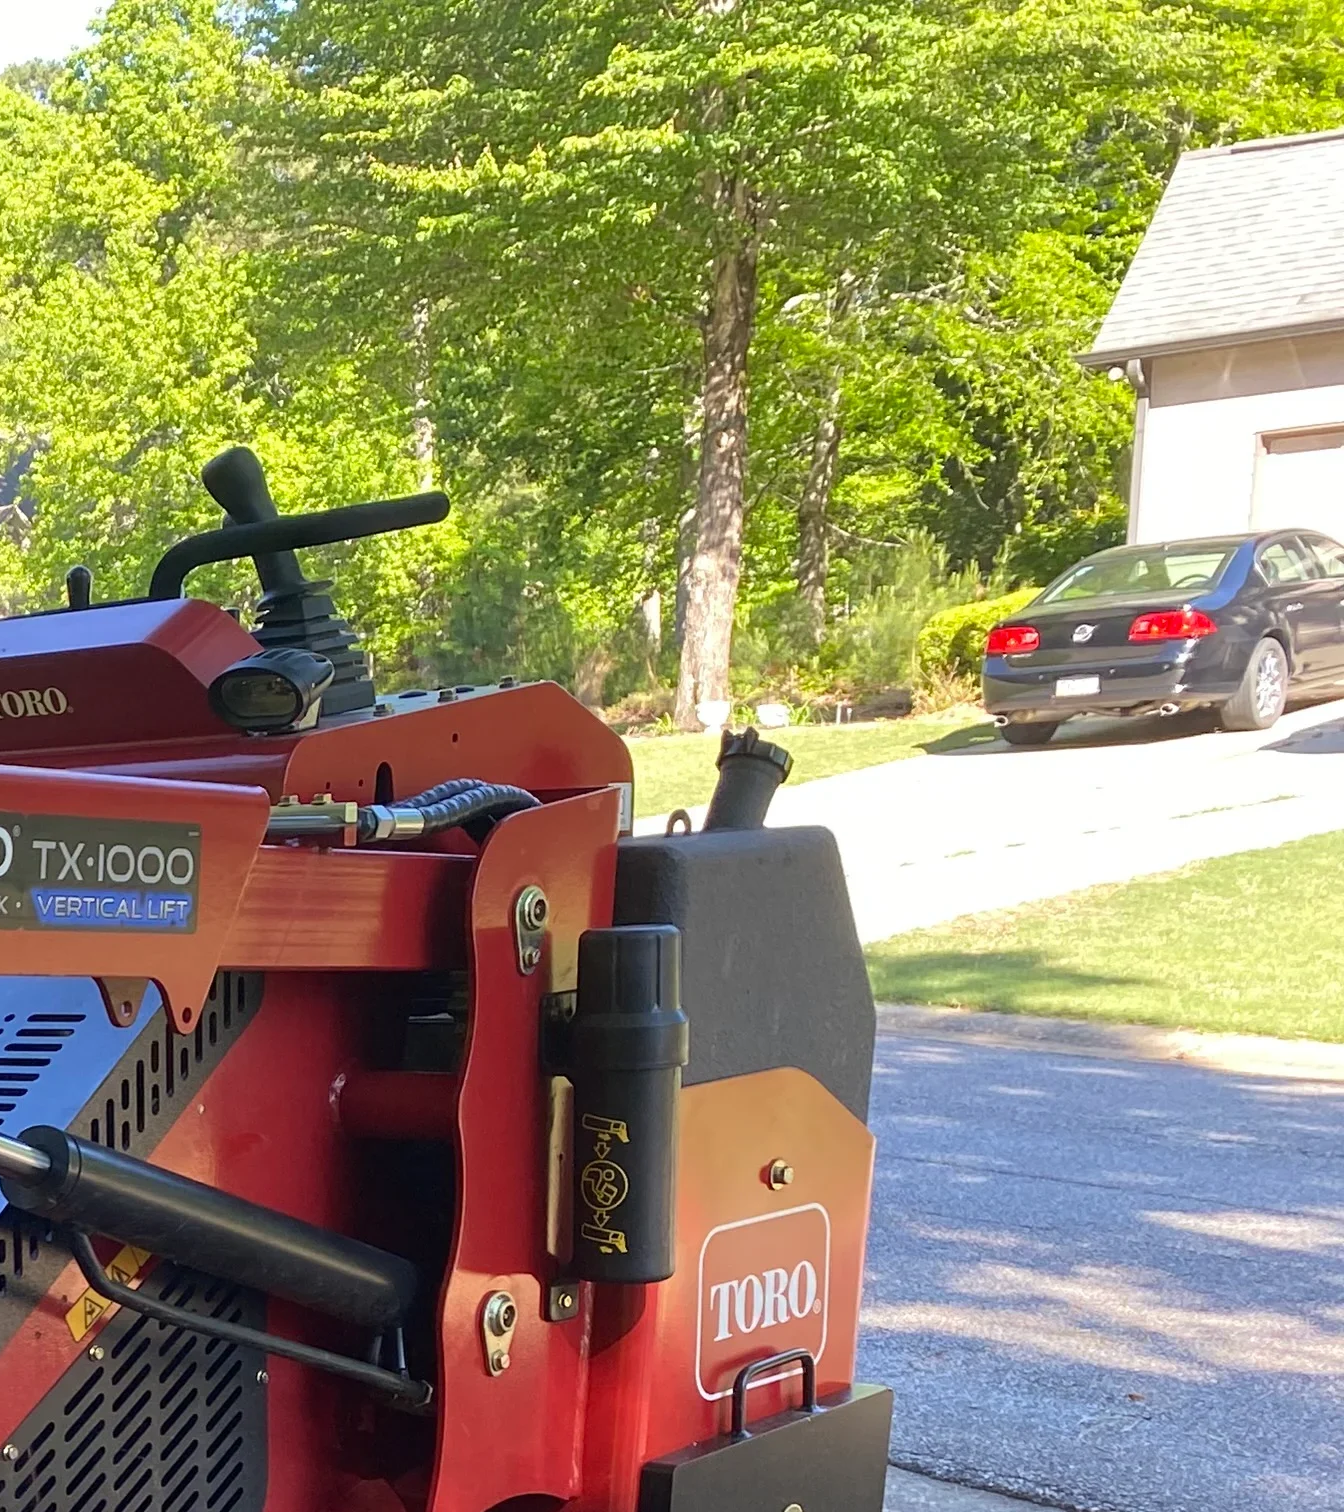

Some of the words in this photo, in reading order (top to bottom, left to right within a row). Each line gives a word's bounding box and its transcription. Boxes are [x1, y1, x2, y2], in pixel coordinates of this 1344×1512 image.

[38, 895, 142, 920] VERTICAL
[147, 898, 188, 921] LIFT
[710, 1260, 817, 1342] TORO
